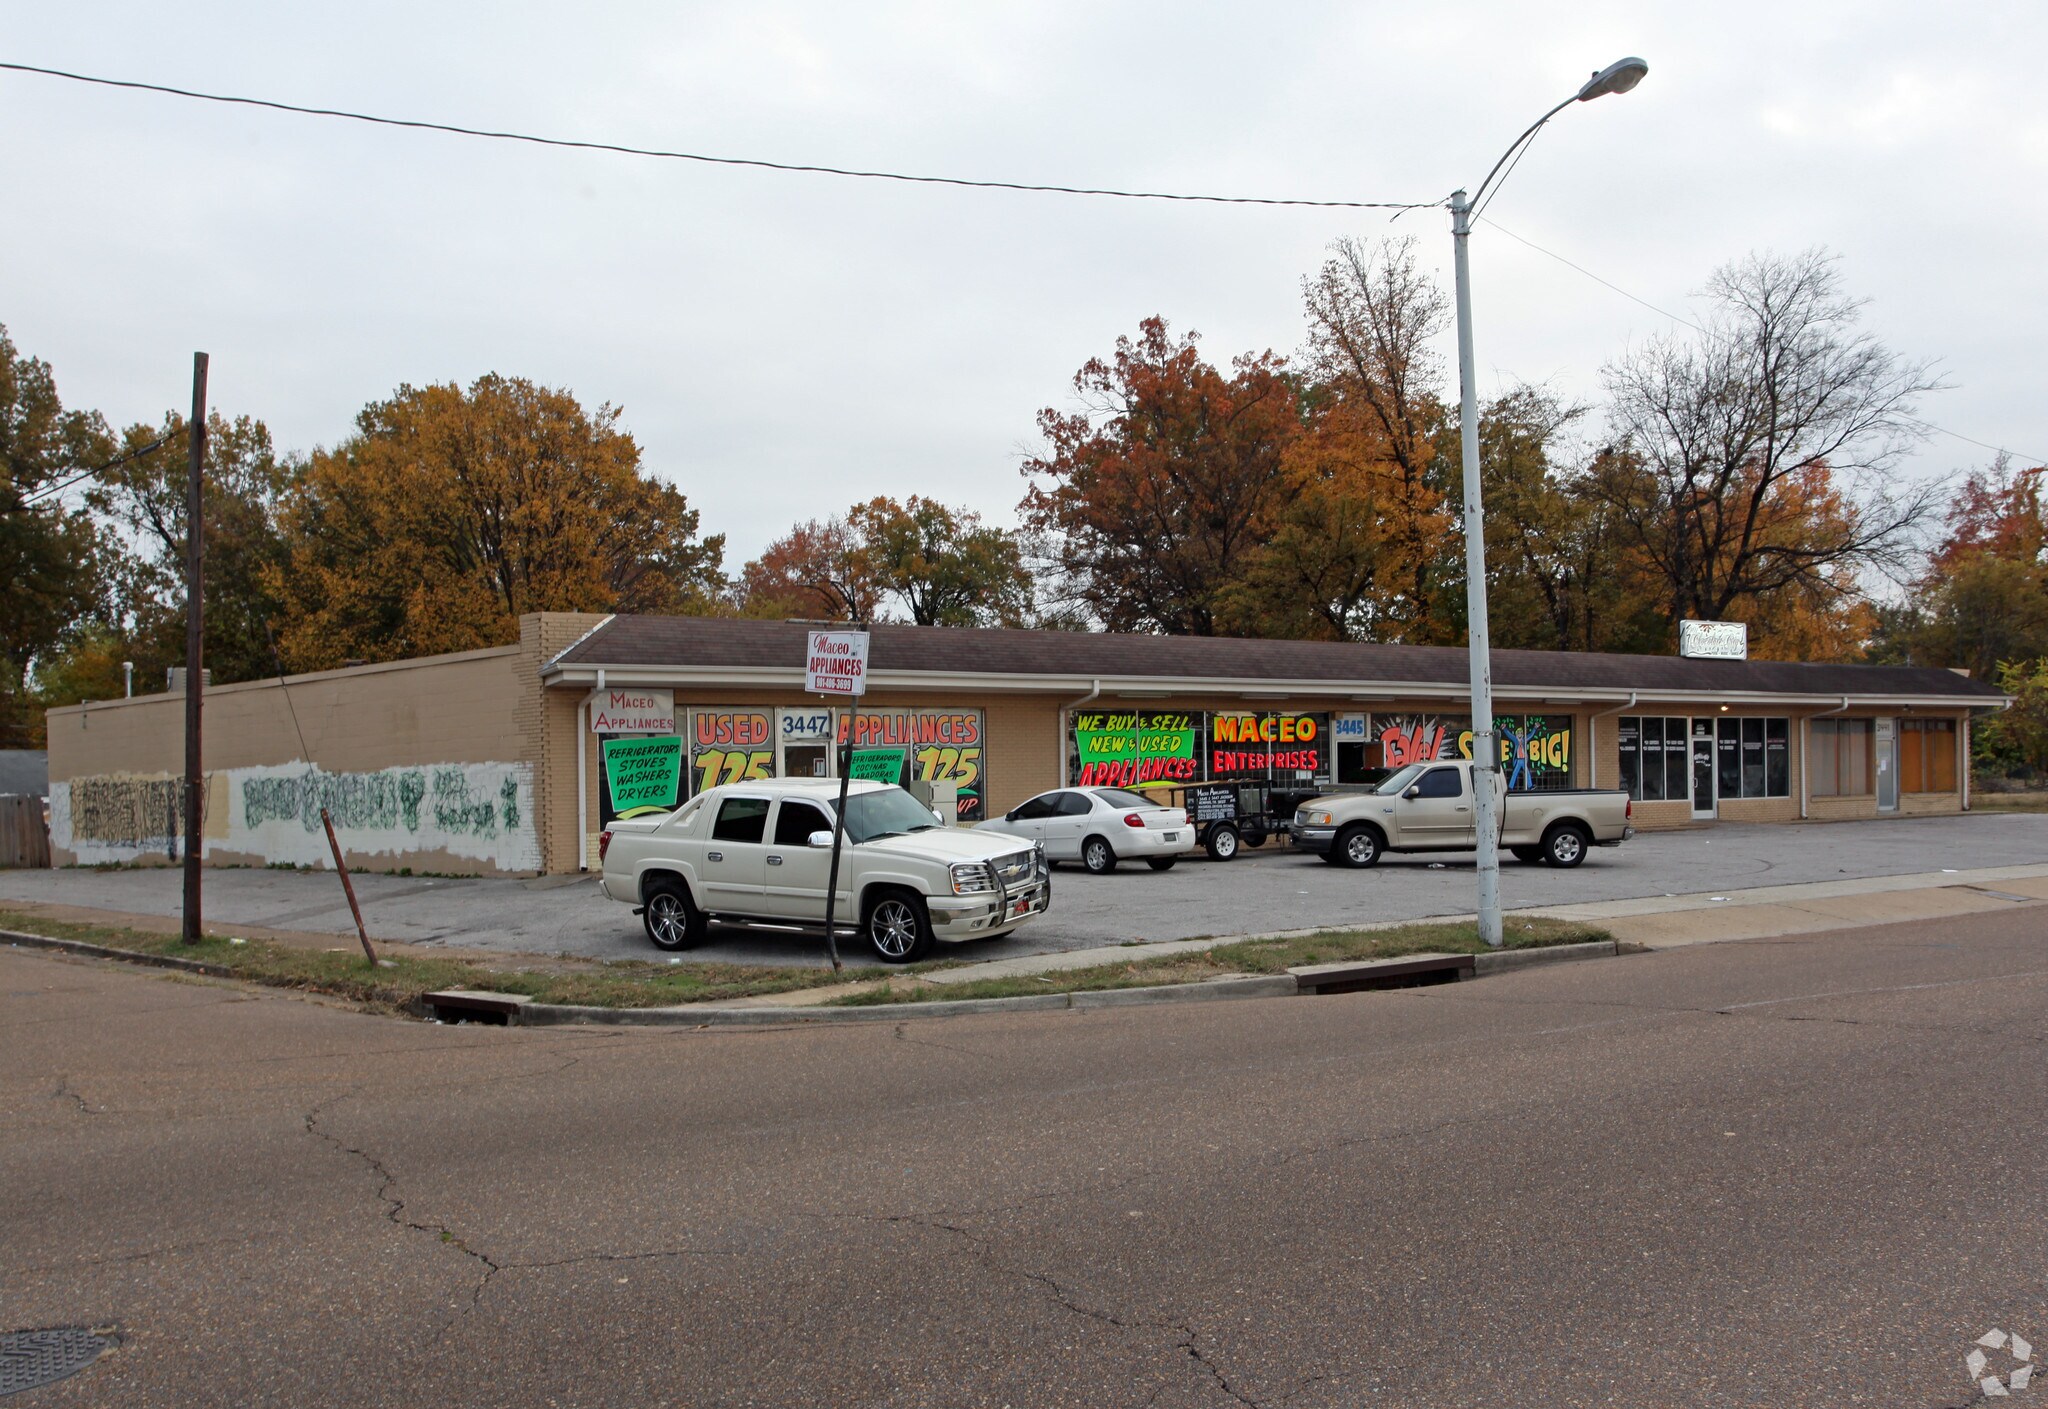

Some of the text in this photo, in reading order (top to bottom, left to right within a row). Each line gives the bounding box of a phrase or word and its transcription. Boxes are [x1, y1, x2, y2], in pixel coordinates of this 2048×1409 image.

[814, 634, 849, 655] Maceo
[810, 657, 862, 676] APPLIANCES
[610, 691, 654, 709] MACEO
[594, 712, 674, 730] APPLIANCES
[697, 713, 769, 745] USED
[783, 716, 828, 733] 3447
[837, 714, 979, 744] APPLIANCES
[1077, 715, 1104, 732] WE
[1105, 715, 1137, 732] BUY
[1149, 715, 1190, 732] SELL
[1213, 716, 1317, 743] MACEO
[1336, 719, 1363, 735] 3445
[608, 744, 680, 759] REFRIGERATORS
[1088, 736, 1126, 753] NEW
[1140, 735, 1182, 753] USED
[1529, 729, 1570, 773] BIG!
[619, 757, 668, 772] STOVES
[855, 763, 888, 772] COCINAS
[1213, 750, 1318, 773] ENTERPRISES
[616, 769, 672, 786] WASHERS
[1078, 756, 1197, 788] APPLIANCES
[617, 785, 668, 801] DRYERS
[957, 798, 979, 813] UP
